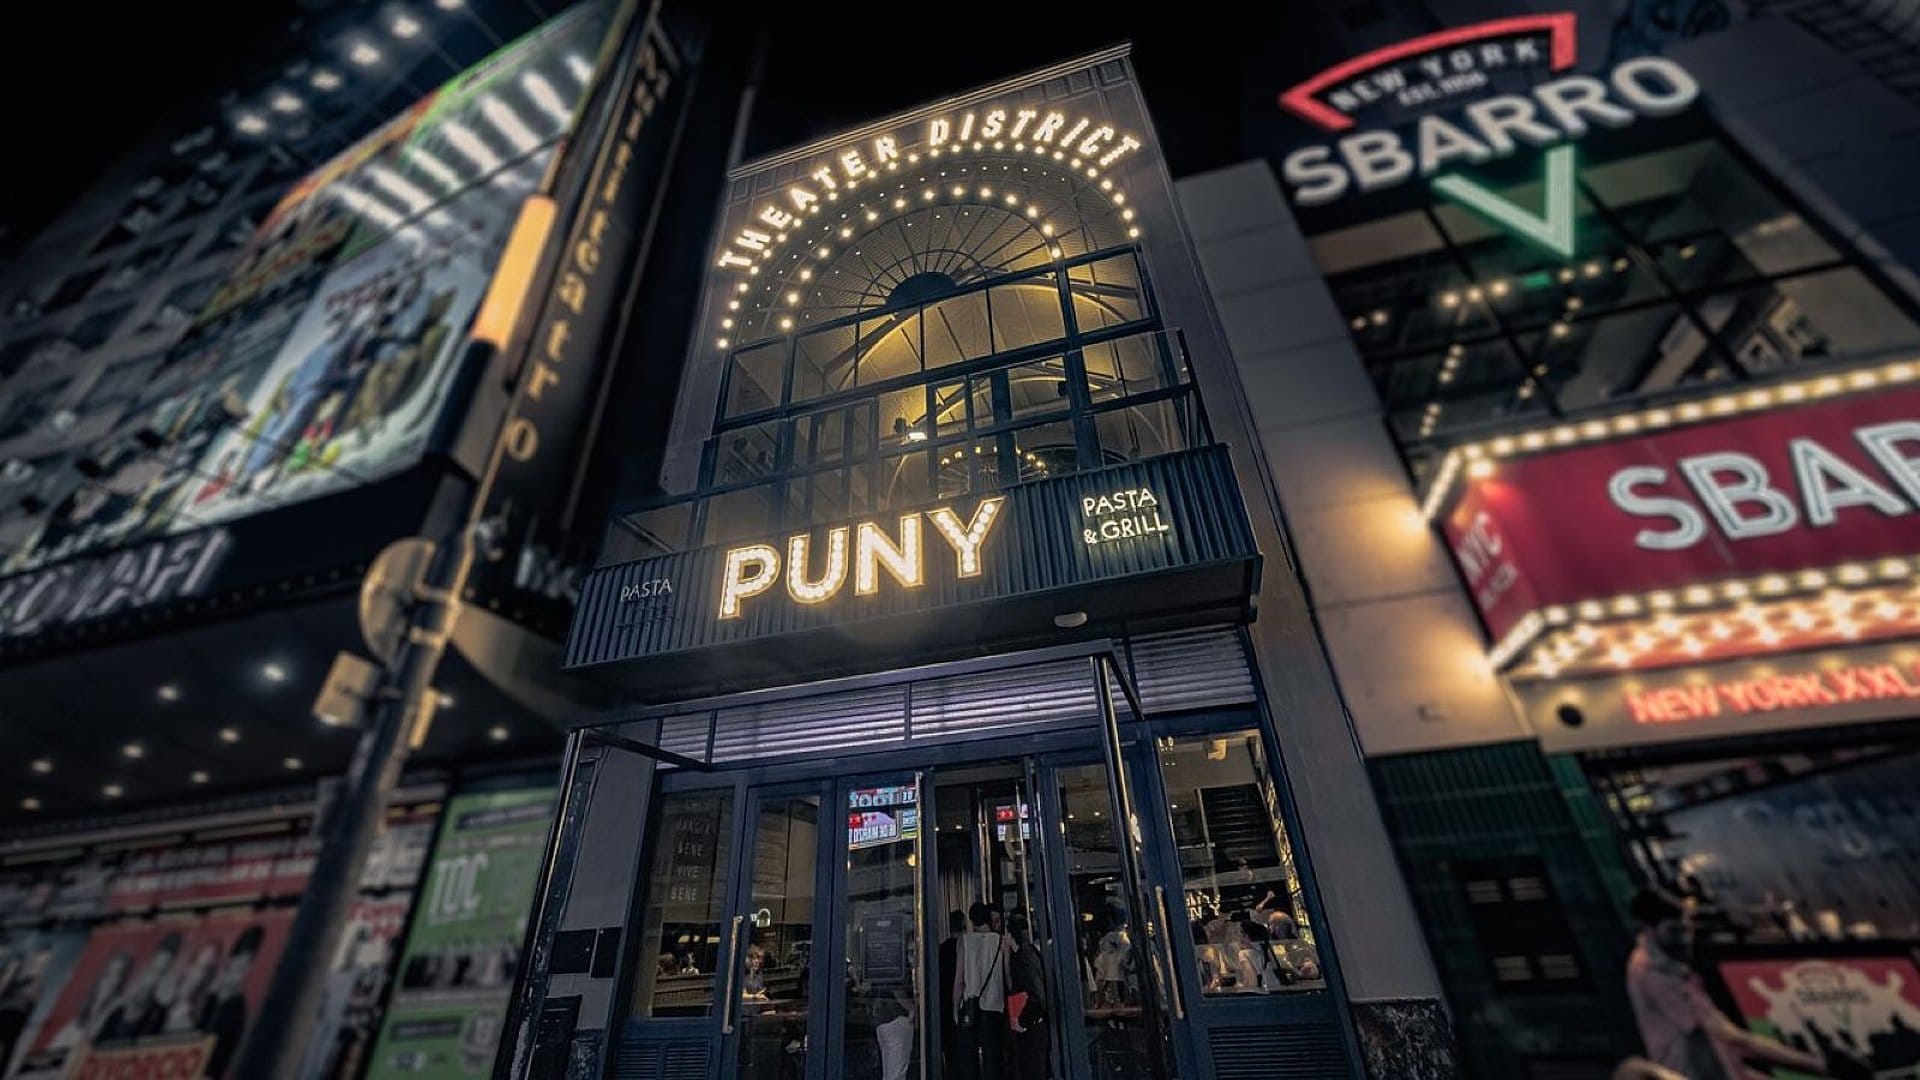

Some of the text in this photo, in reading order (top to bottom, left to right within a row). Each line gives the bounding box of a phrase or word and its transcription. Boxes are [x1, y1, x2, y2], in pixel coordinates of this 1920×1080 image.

[1328, 38, 1541, 112] NEW YORK
[1283, 56, 1699, 207] SBARRO
[718, 109, 1141, 267] THEATER DISTRICT
[1083, 488, 1158, 518] PASTA
[1084, 512, 1169, 545] & GRILL
[620, 578, 673, 602] PASTA
[717, 496, 1006, 620] PUNY
[1625, 685, 1720, 724] NEW
[1717, 670, 1837, 714] YORK
